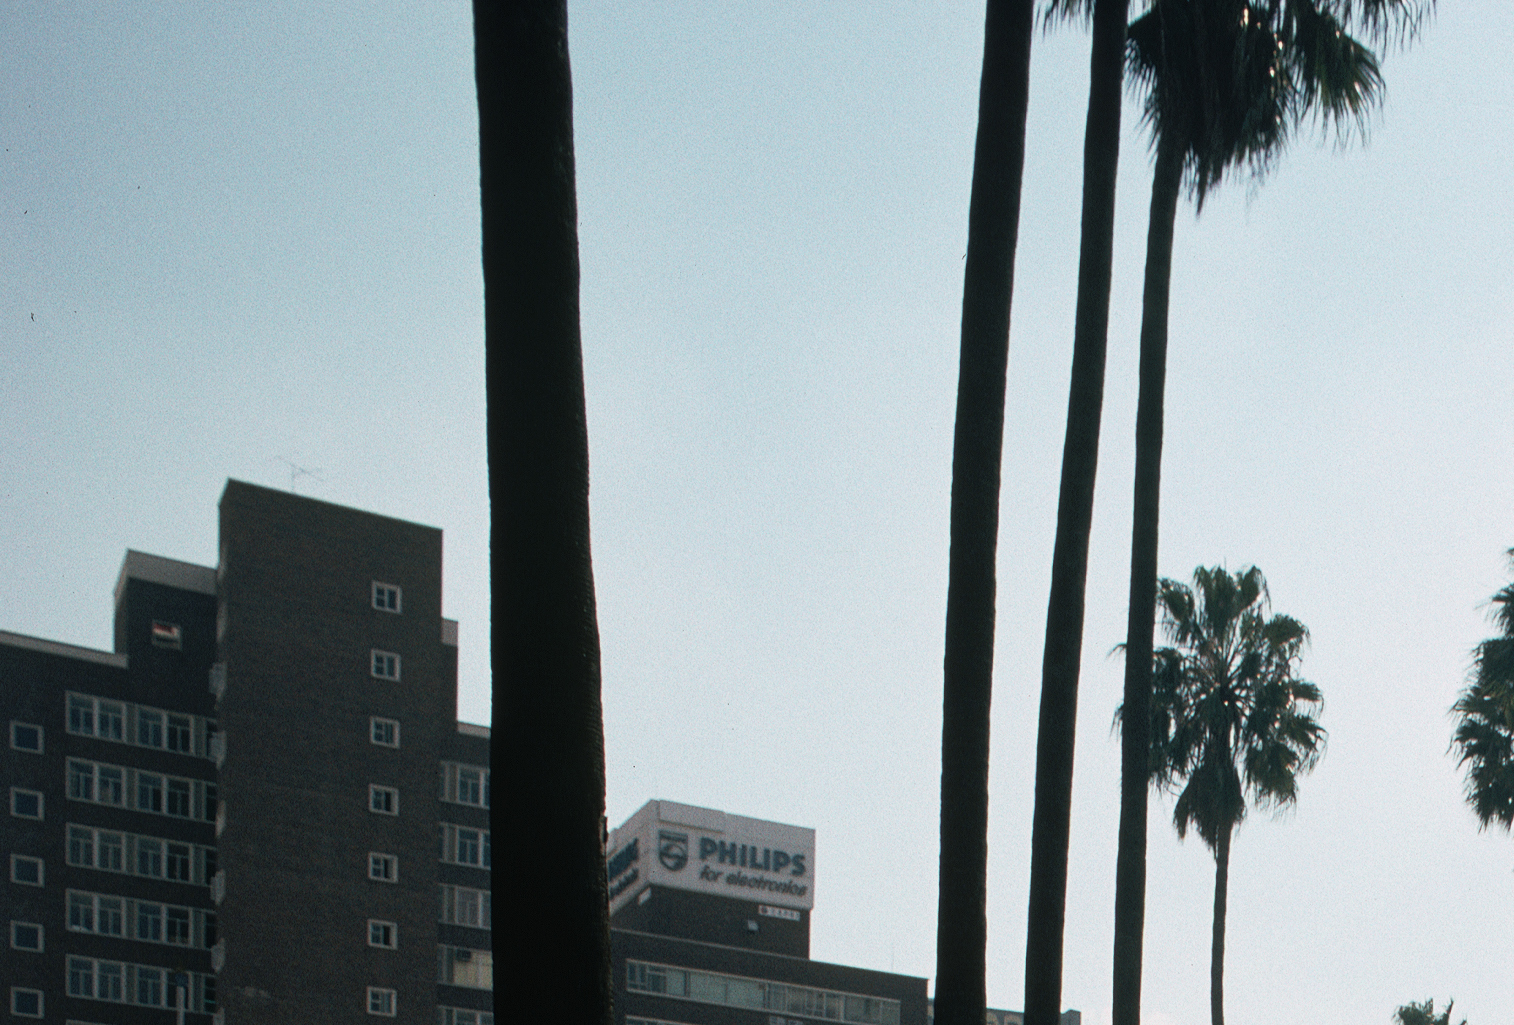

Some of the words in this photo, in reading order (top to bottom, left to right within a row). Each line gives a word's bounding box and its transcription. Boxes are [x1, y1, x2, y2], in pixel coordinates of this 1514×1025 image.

[699, 836, 806, 876] PHILIPS
[700, 864, 723, 882] for
[726, 871, 808, 897] electronics
